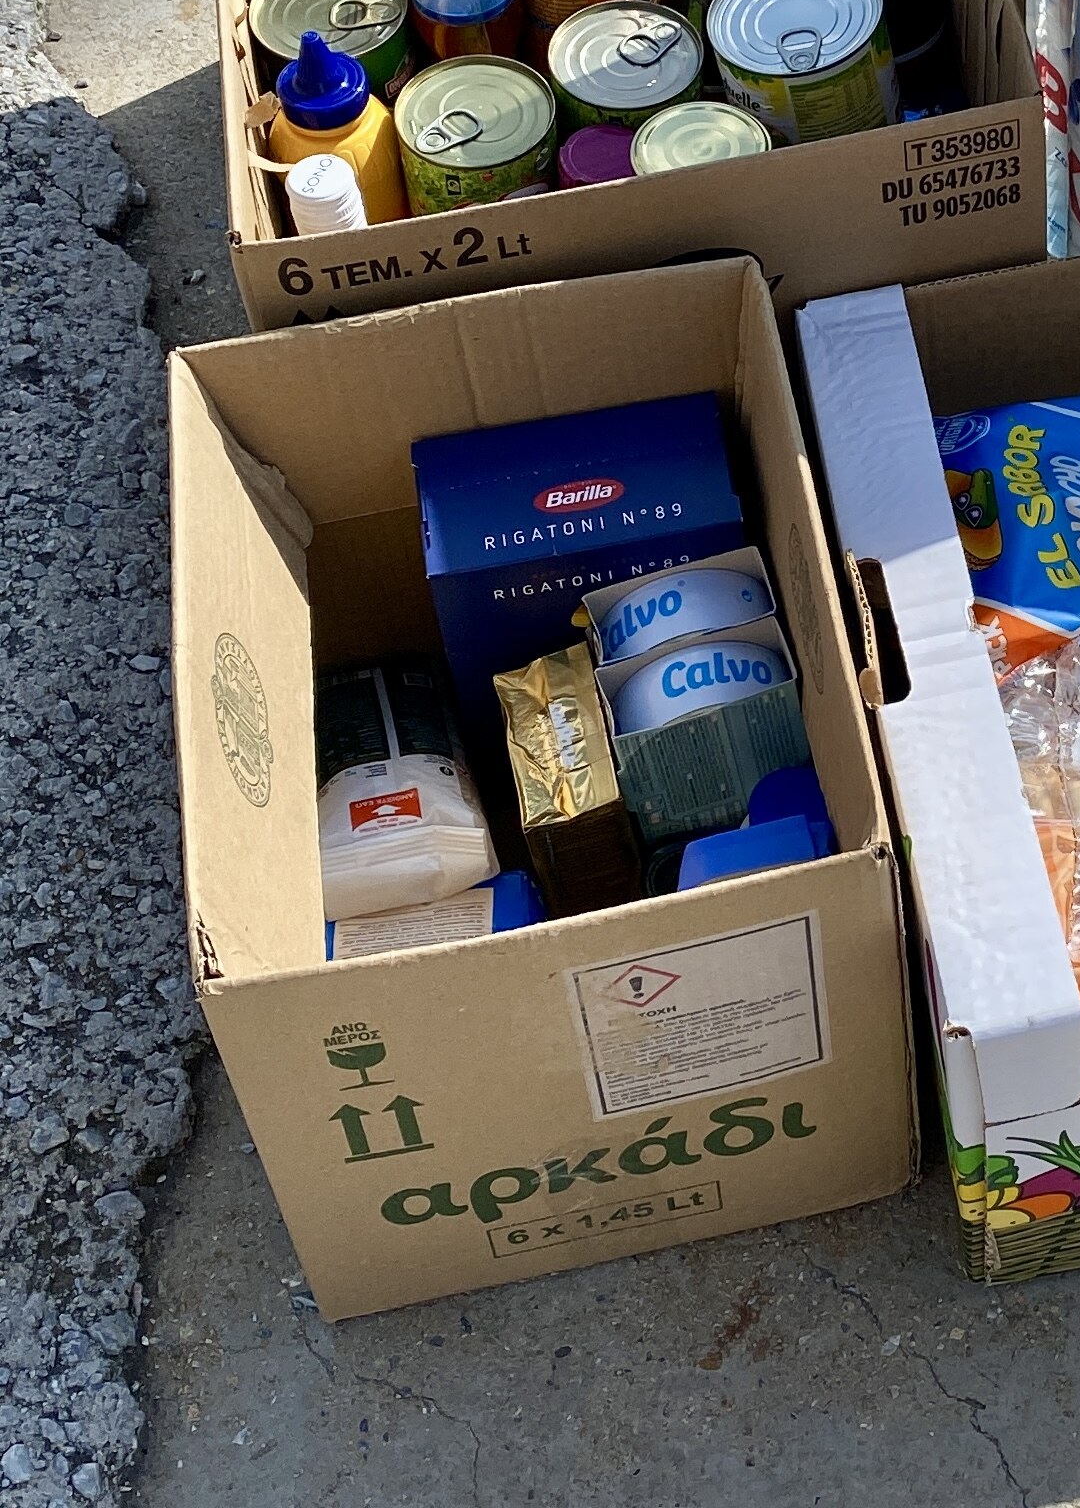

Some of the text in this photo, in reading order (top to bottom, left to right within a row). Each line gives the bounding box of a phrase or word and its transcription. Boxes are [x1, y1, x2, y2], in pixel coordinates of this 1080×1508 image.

[911, 143, 927, 167] T
[930, 125, 1015, 163] 353980
[881, 175, 915, 204] DU
[918, 156, 1022, 196] 65476733
[899, 184, 1022, 227] TU 9052068
[277, 256, 314, 296] 6
[452, 225, 490, 267] 2
[496, 232, 532, 259] Lt
[543, 481, 618, 510] Barilla
[1003, 423, 1055, 527] SABOR
[483, 516, 606, 550] RIGATONI
[493, 570, 613, 600] RIGATONI
[661, 651, 773, 698] Calvo
[322, 1028, 382, 1048] ΜΕΡΟΣ
[330, 1021, 367, 1037] ΑΝΩ
[380, 1098, 818, 1225] αρκάδι
[505, 1227, 530, 1245] 6
[667, 1190, 706, 1210] Lt
